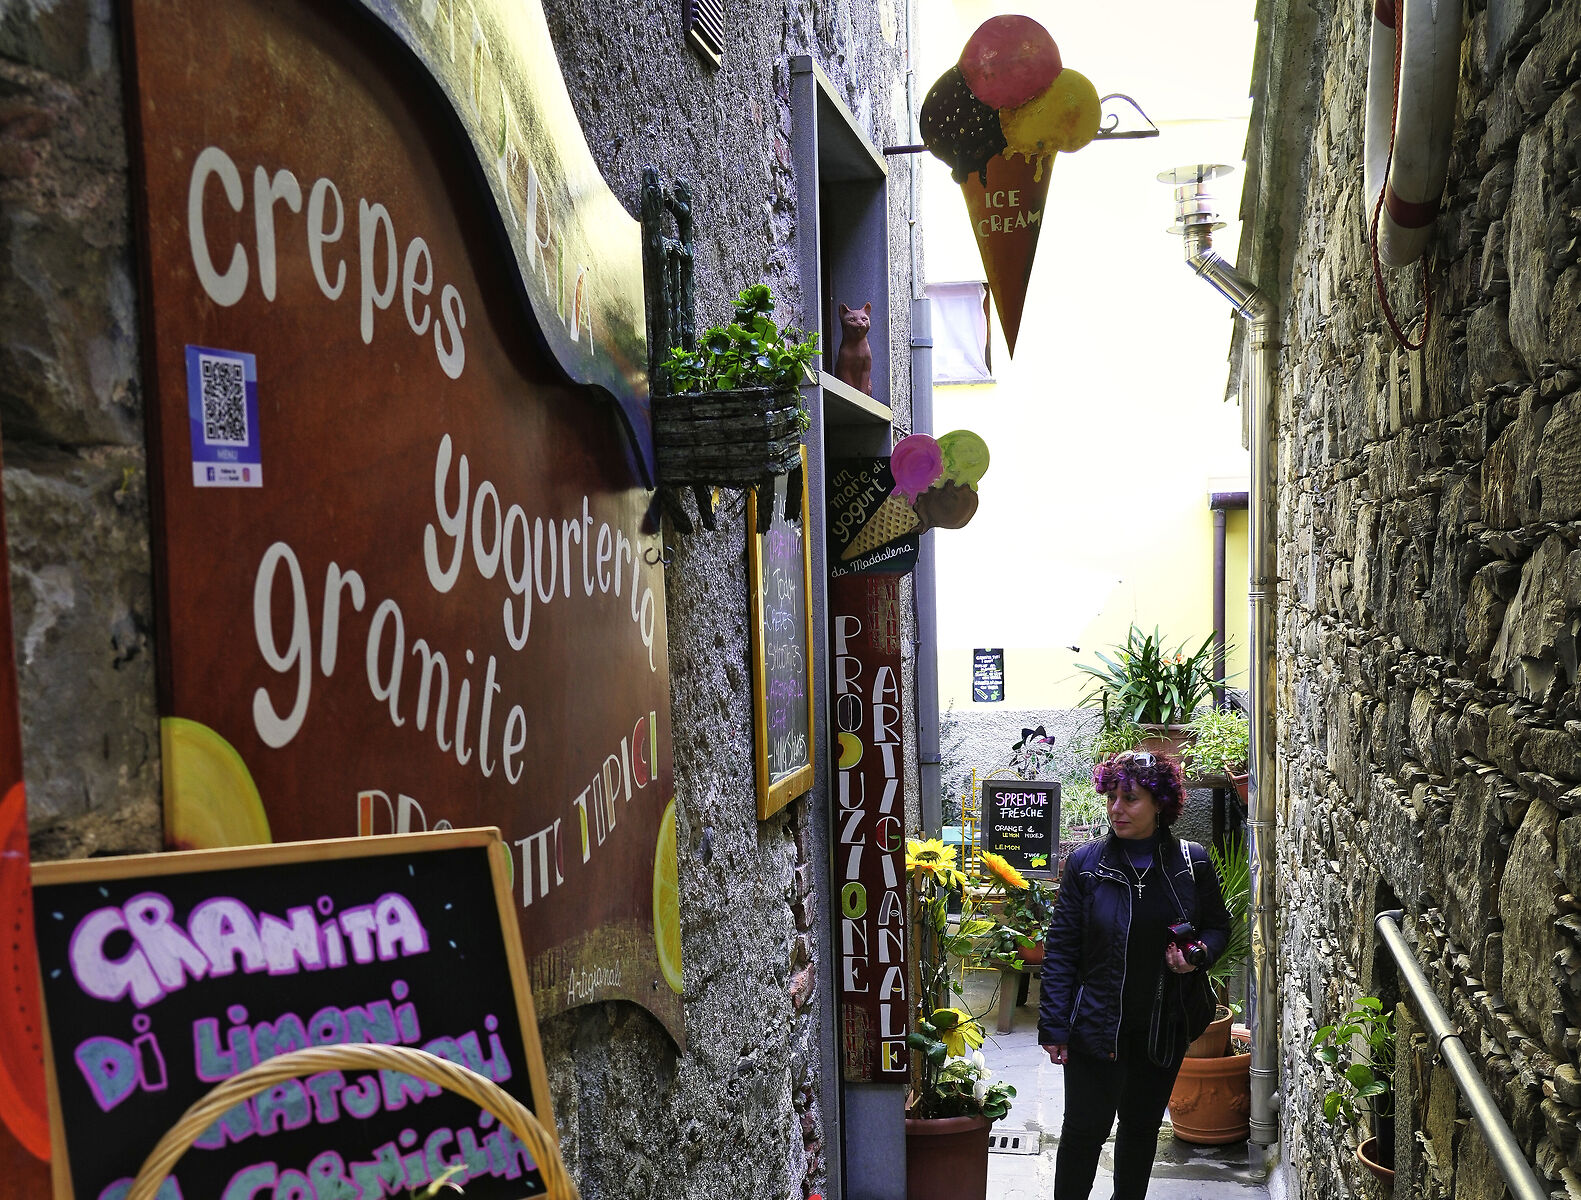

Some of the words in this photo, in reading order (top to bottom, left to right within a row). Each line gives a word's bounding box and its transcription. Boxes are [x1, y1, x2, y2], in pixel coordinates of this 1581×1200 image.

[977, 209, 1041, 237] CREAM
[985, 189, 1020, 208] ICE
[188, 146, 466, 379] crepes
[830, 471, 871, 509] mare
[873, 460, 886, 474] di
[832, 469, 854, 487] un
[832, 478, 887, 543] yogurt
[424, 433, 657, 673] yogurteria
[850, 543, 914, 572] Maddalena
[252, 541, 527, 785] granite
[573, 710, 658, 864] TIPICI
[835, 615, 870, 993] PRODUZIONE
[995, 792, 1049, 807] SPREMUTE
[994, 824, 1023, 833] ORANGE
[872, 666, 907, 1073] ARTIGIANALE
